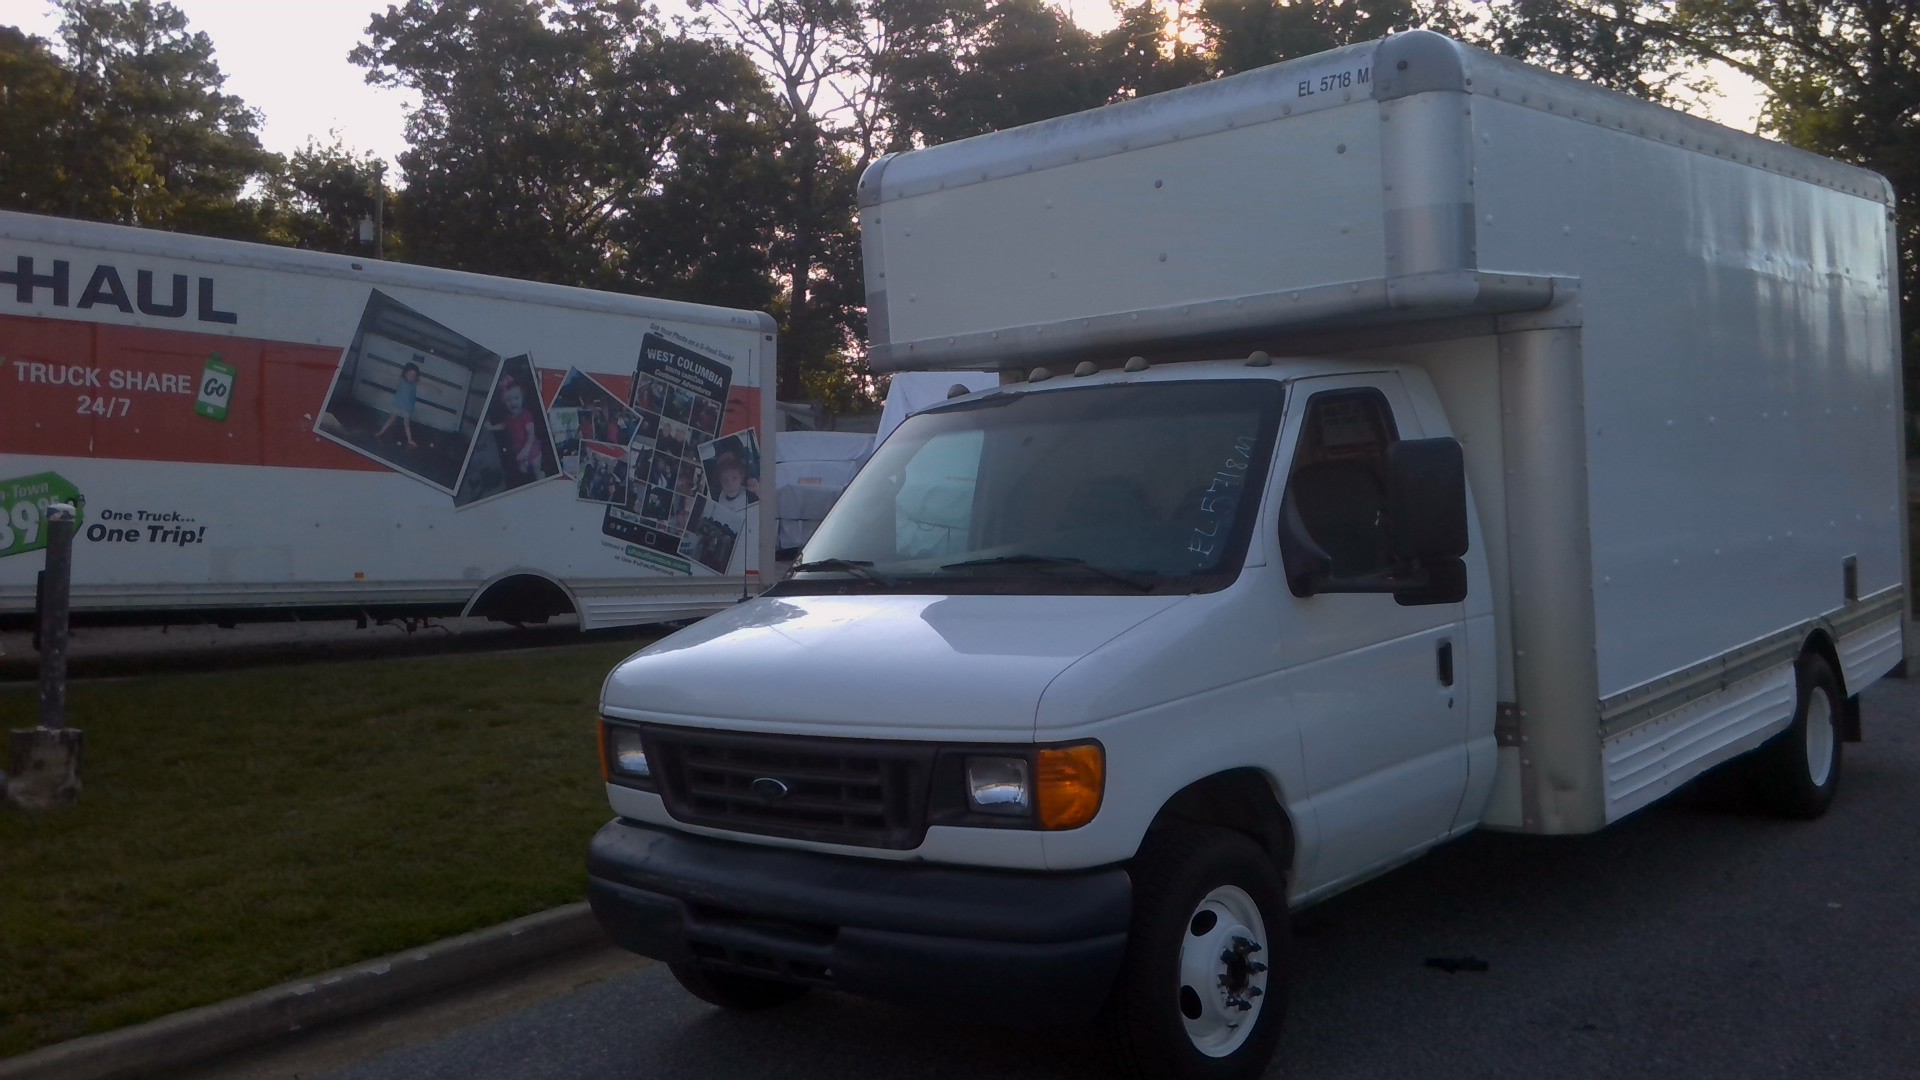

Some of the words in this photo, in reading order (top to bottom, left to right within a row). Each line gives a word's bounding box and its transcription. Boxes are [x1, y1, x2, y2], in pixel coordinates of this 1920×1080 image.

[1298, 80, 1315, 98] EL
[1320, 71, 1351, 92] 5718
[1357, 67, 1369, 85] M
[14, 361, 101, 388] TRUCK
[109, 369, 191, 395] SHARE
[647, 347, 676, 365] WEST
[677, 355, 724, 389] COLUMBIA
[203, 376, 227, 399] Go
[77, 395, 131, 418] 24/7
[101, 508, 133, 522] One
[137, 510, 195, 523] Truck...
[87, 523, 139, 544] One
[147, 524, 206, 547] Trip!
